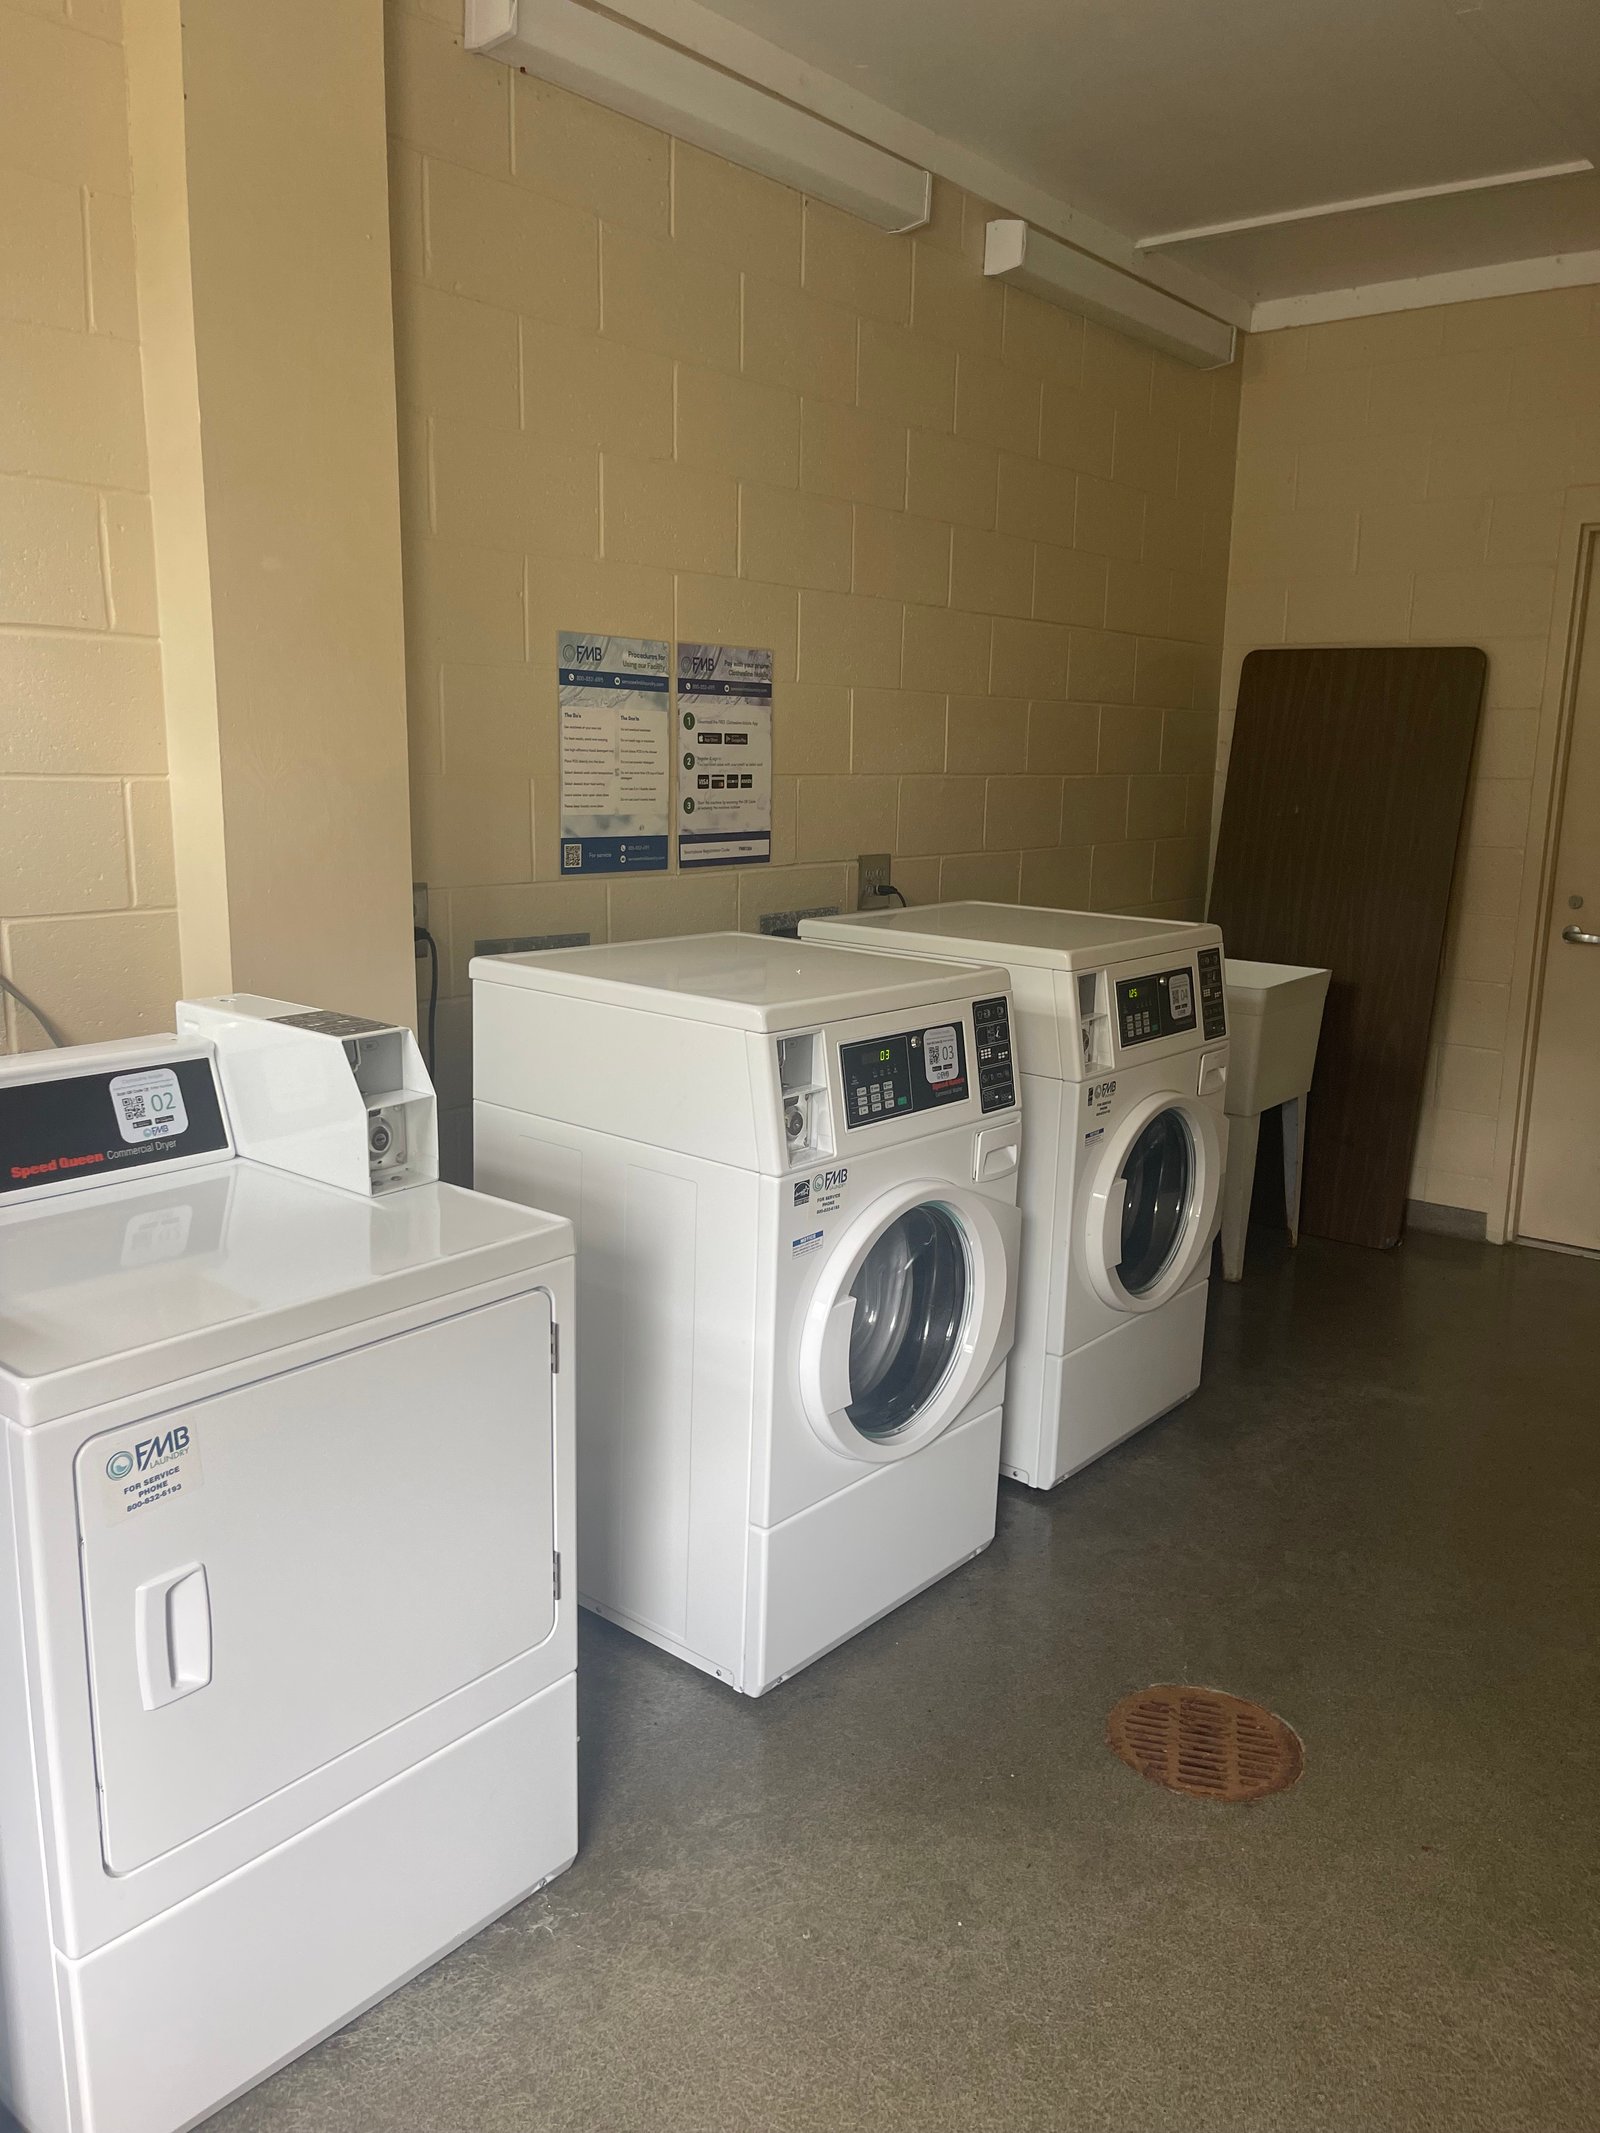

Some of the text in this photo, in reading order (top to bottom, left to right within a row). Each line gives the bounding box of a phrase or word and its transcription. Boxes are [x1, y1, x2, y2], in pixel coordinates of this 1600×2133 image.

[576, 645, 602, 664] FMB
[628, 651, 666, 661] Procedures for
[622, 660, 637, 670] Using
[692, 657, 715, 674] FMB
[879, 1049, 890, 1061] 03
[942, 1046, 954, 1061] 03
[150, 1092, 176, 1112] 02
[151, 1124, 169, 1137] FMB
[10, 1139, 177, 1179] Speed Queen Commercial Dryer
[824, 1168, 848, 1191] FMB
[825, 1193, 841, 1201] SERVICE
[134, 1426, 190, 1472] FMB
[150, 1447, 190, 1469] LAUNDRY
[123, 1465, 181, 1495] FOR SERVICE
[138, 1480, 169, 1498] PHONE
